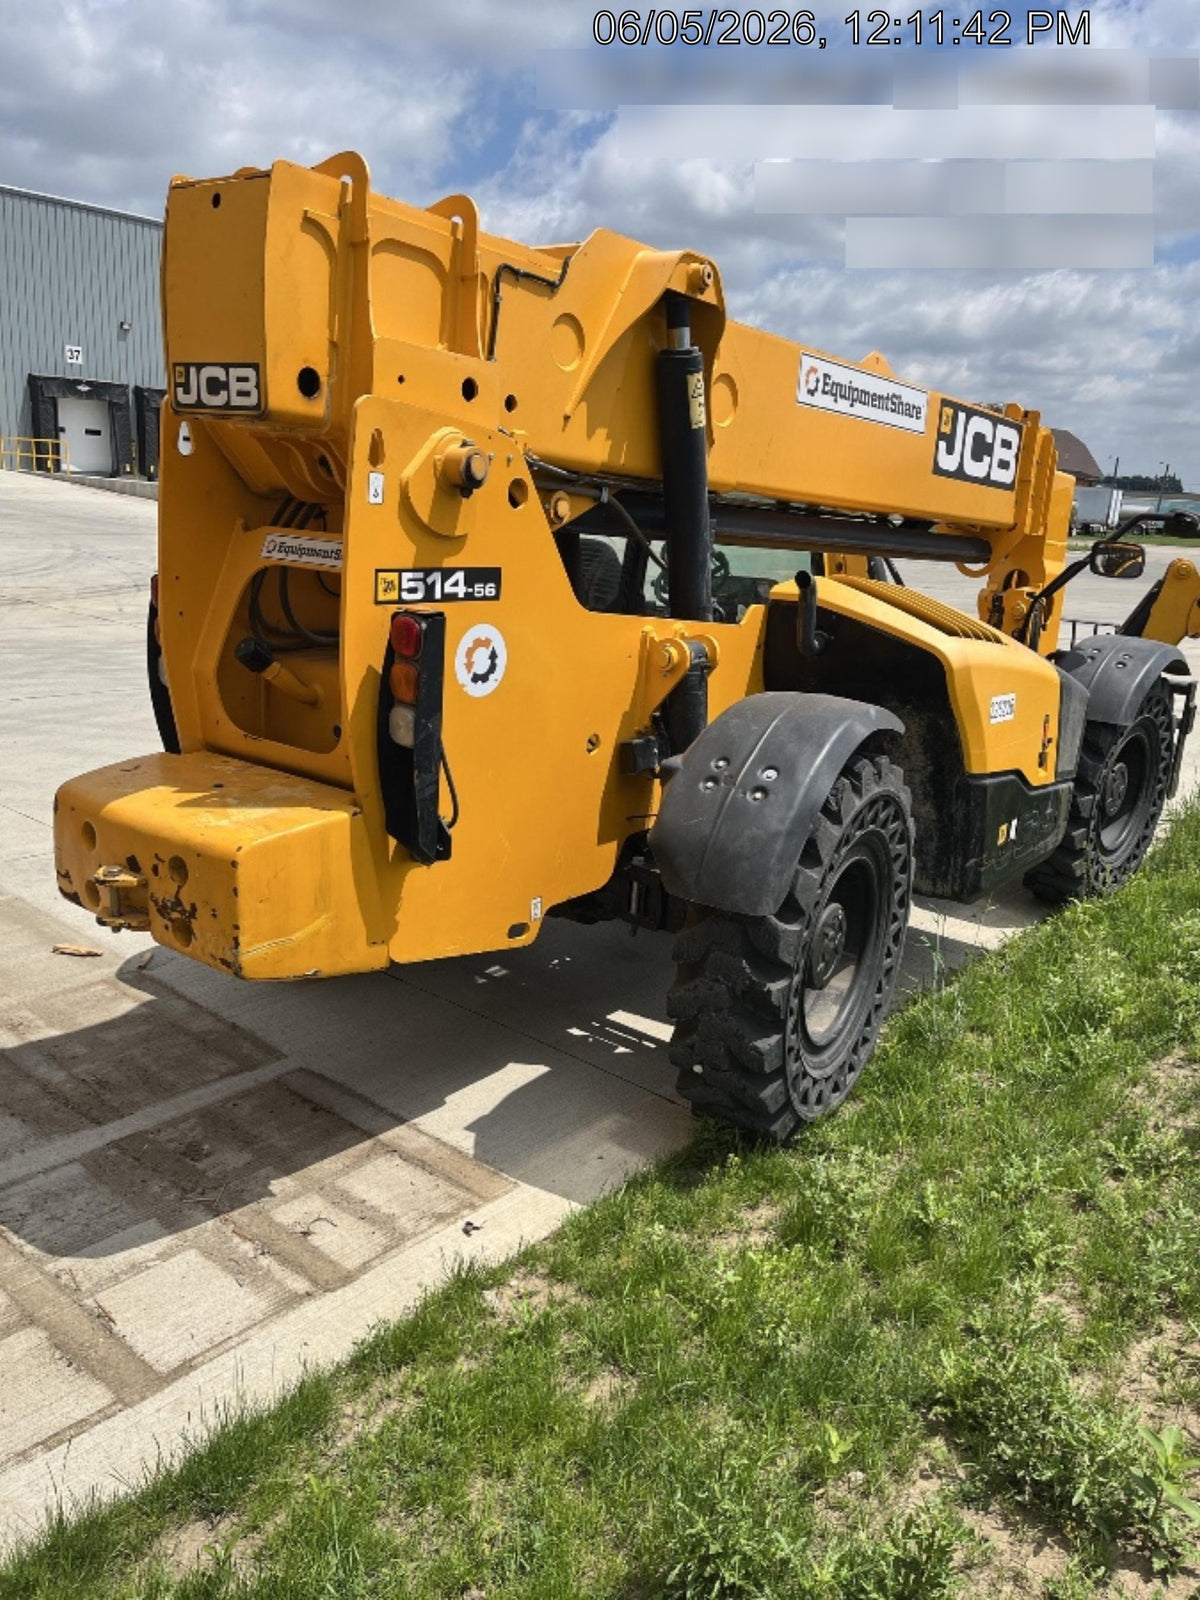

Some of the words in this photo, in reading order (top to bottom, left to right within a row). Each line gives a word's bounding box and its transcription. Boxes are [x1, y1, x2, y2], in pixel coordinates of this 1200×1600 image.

[66, 347, 81, 361] 37
[174, 365, 260, 407] JCB
[820, 372, 923, 421] EquipmentShare
[936, 410, 1020, 485] JCB
[277, 541, 343, 561] EquipmentS
[400, 570, 497, 601] 514-56
